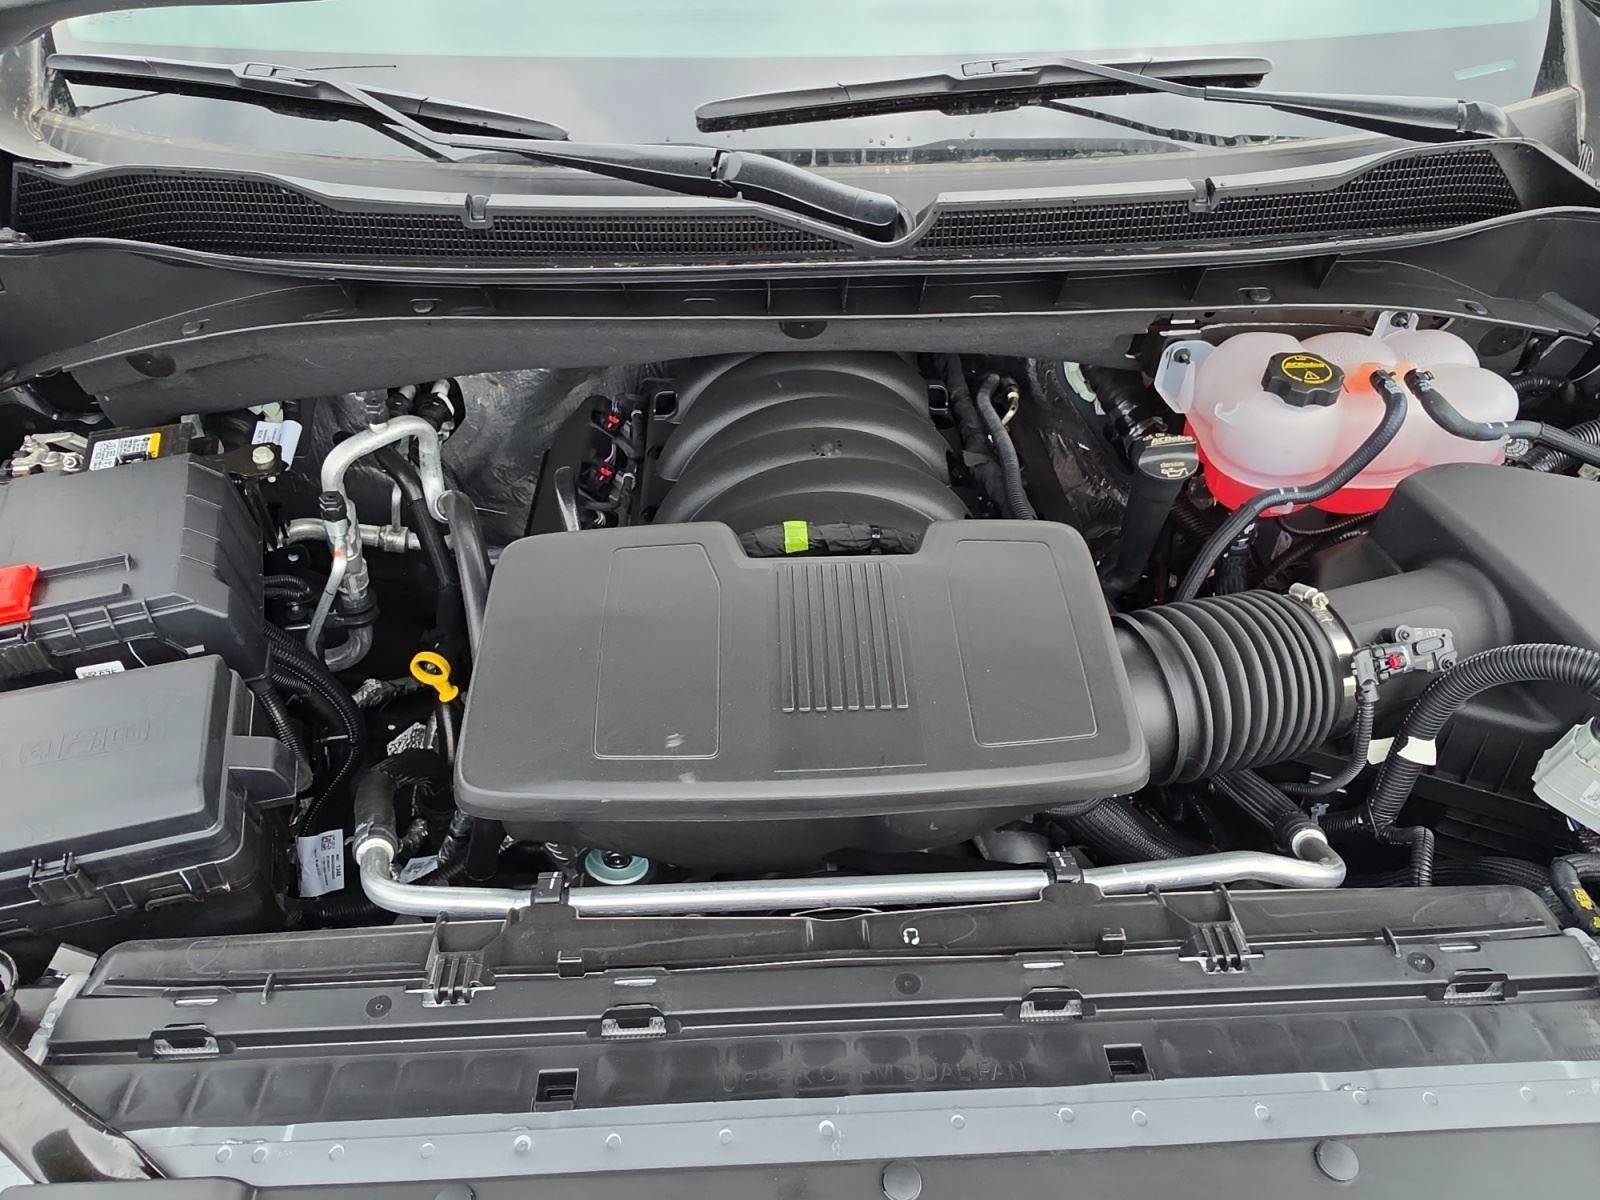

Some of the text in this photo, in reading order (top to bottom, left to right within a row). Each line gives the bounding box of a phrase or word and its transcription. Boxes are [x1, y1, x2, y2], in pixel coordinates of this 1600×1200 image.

[1151, 434, 1194, 446] ACDelco
[903, 1061, 972, 1082] DUAL
[979, 1060, 1027, 1081] FAN
